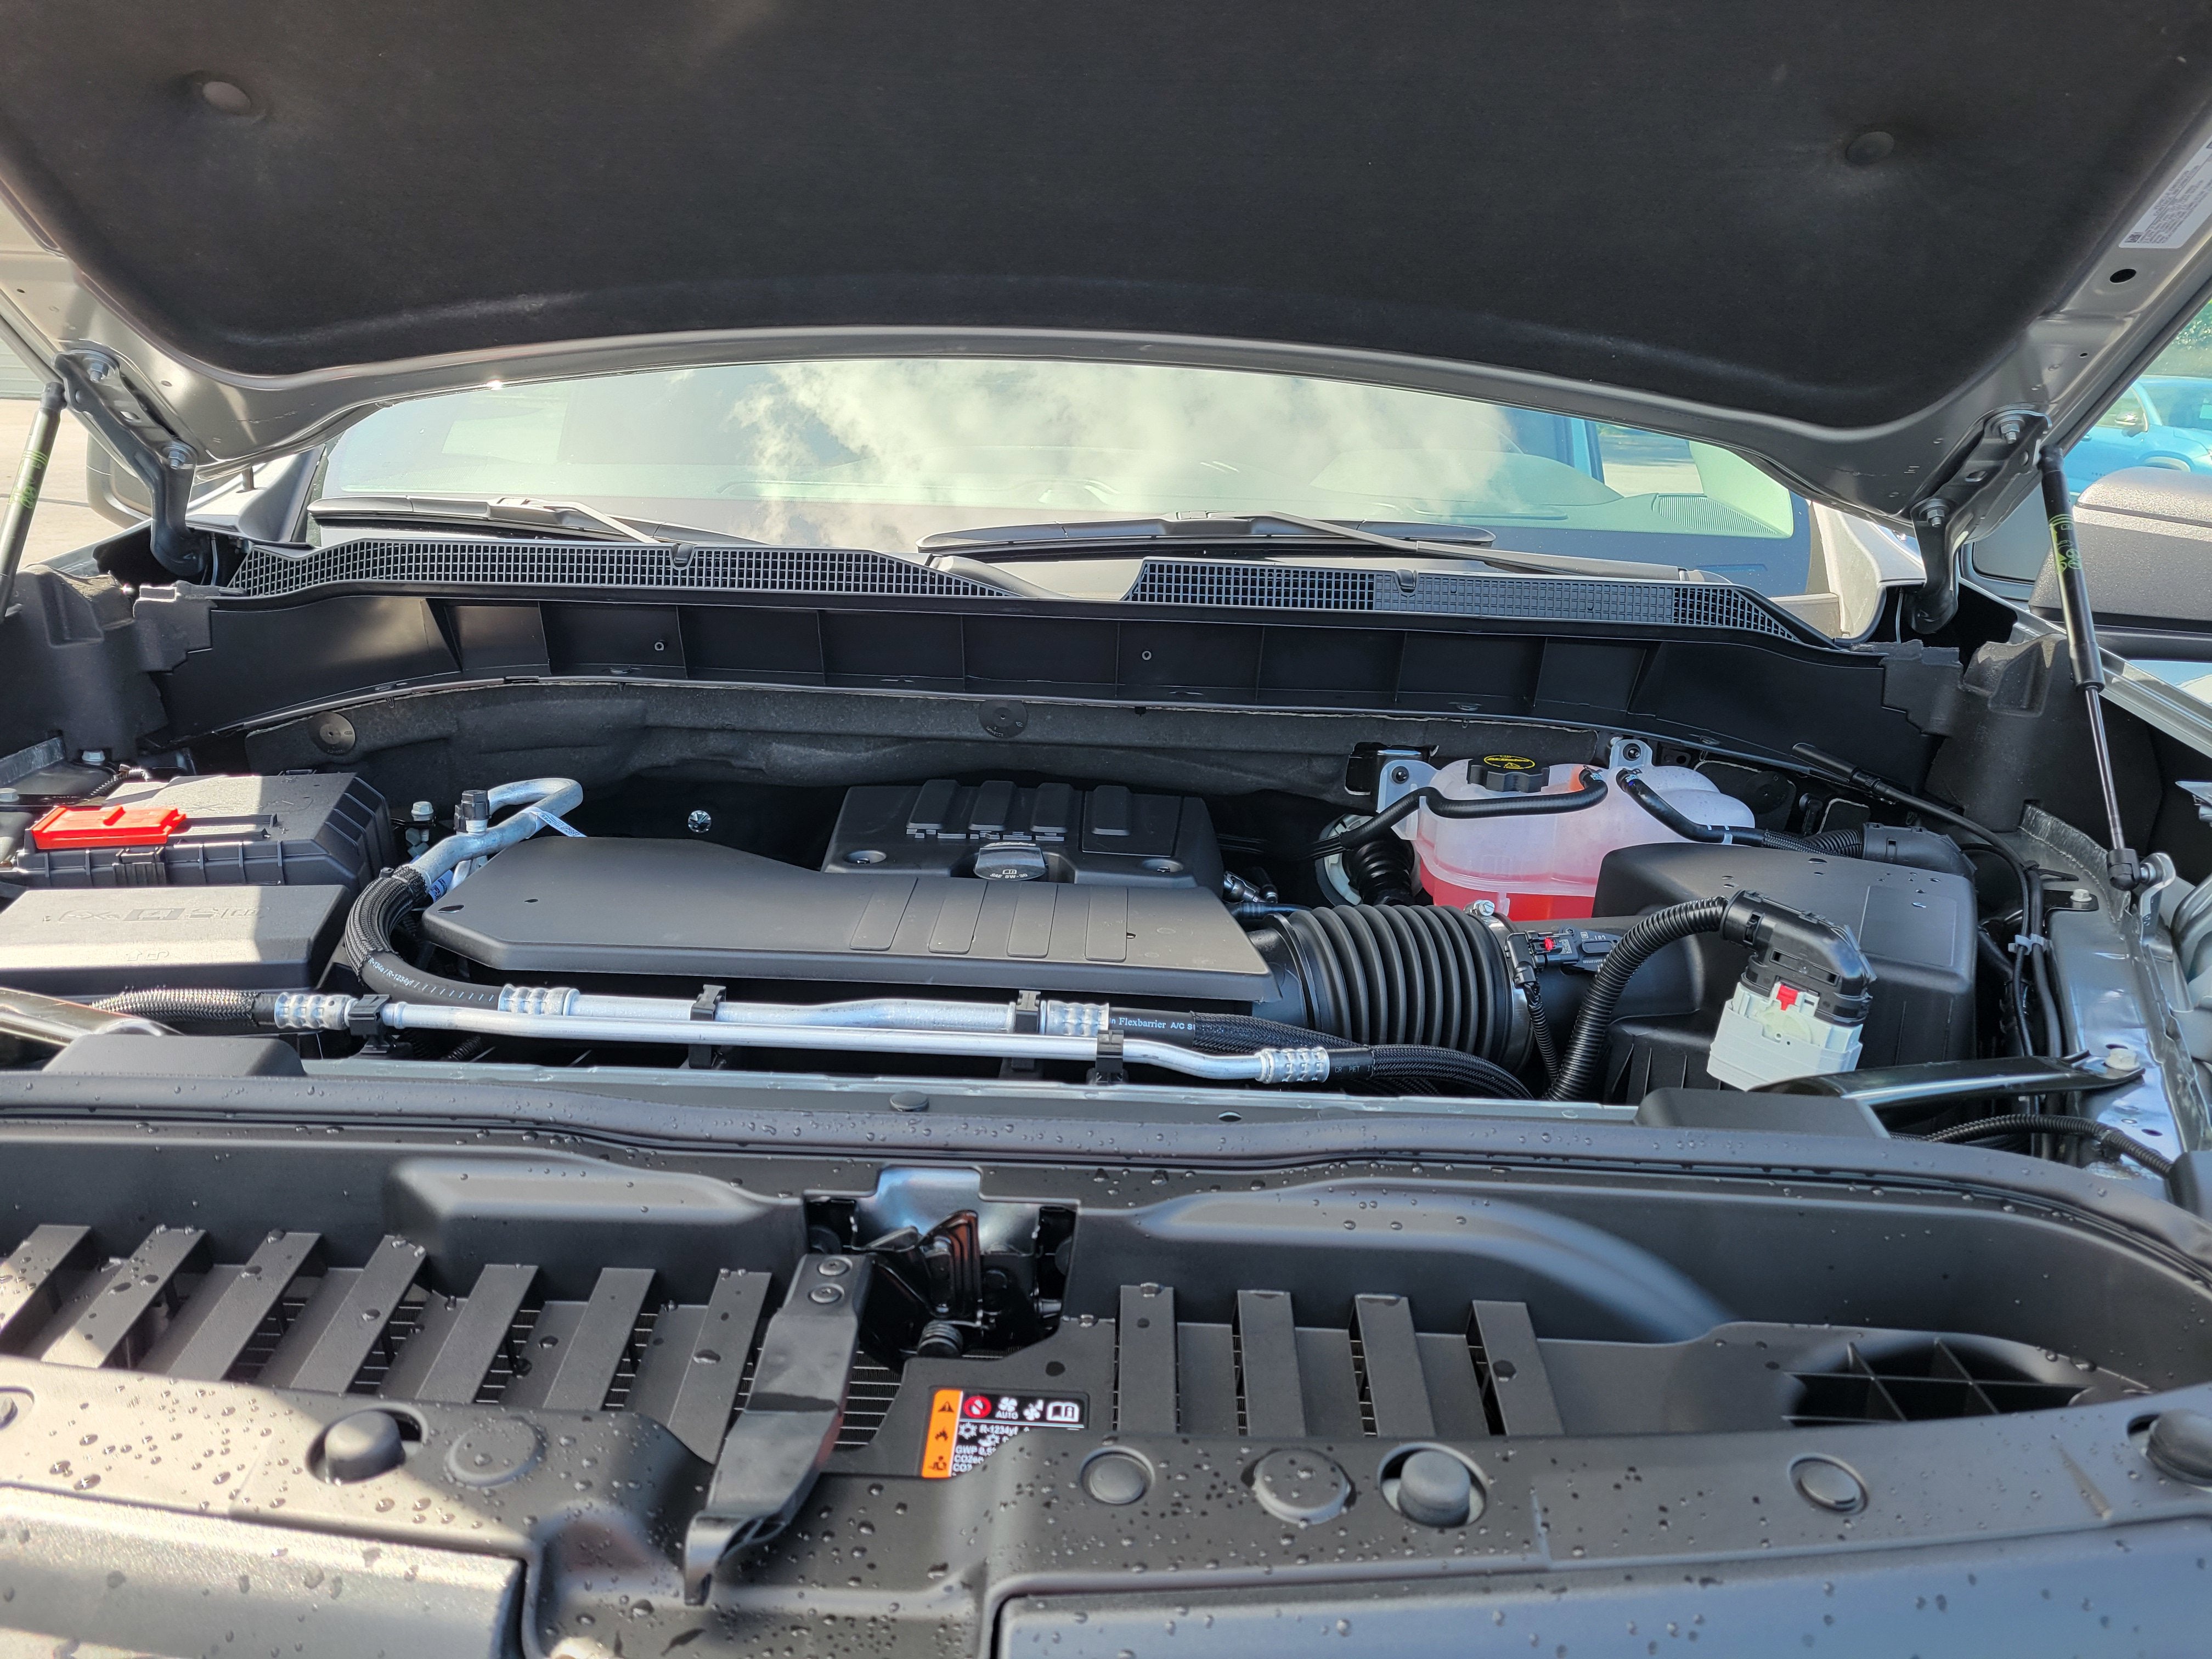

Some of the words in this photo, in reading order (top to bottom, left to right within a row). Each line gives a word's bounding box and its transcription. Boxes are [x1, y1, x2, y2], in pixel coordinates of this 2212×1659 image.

[1119, 1017, 1166, 1029] Flexbarrier
[1170, 1022, 1185, 1030] A/C
[995, 1410, 1019, 1420] AUTO
[979, 1424, 1019, 1436] R-1234yf
[955, 1444, 978, 1454] GWP
